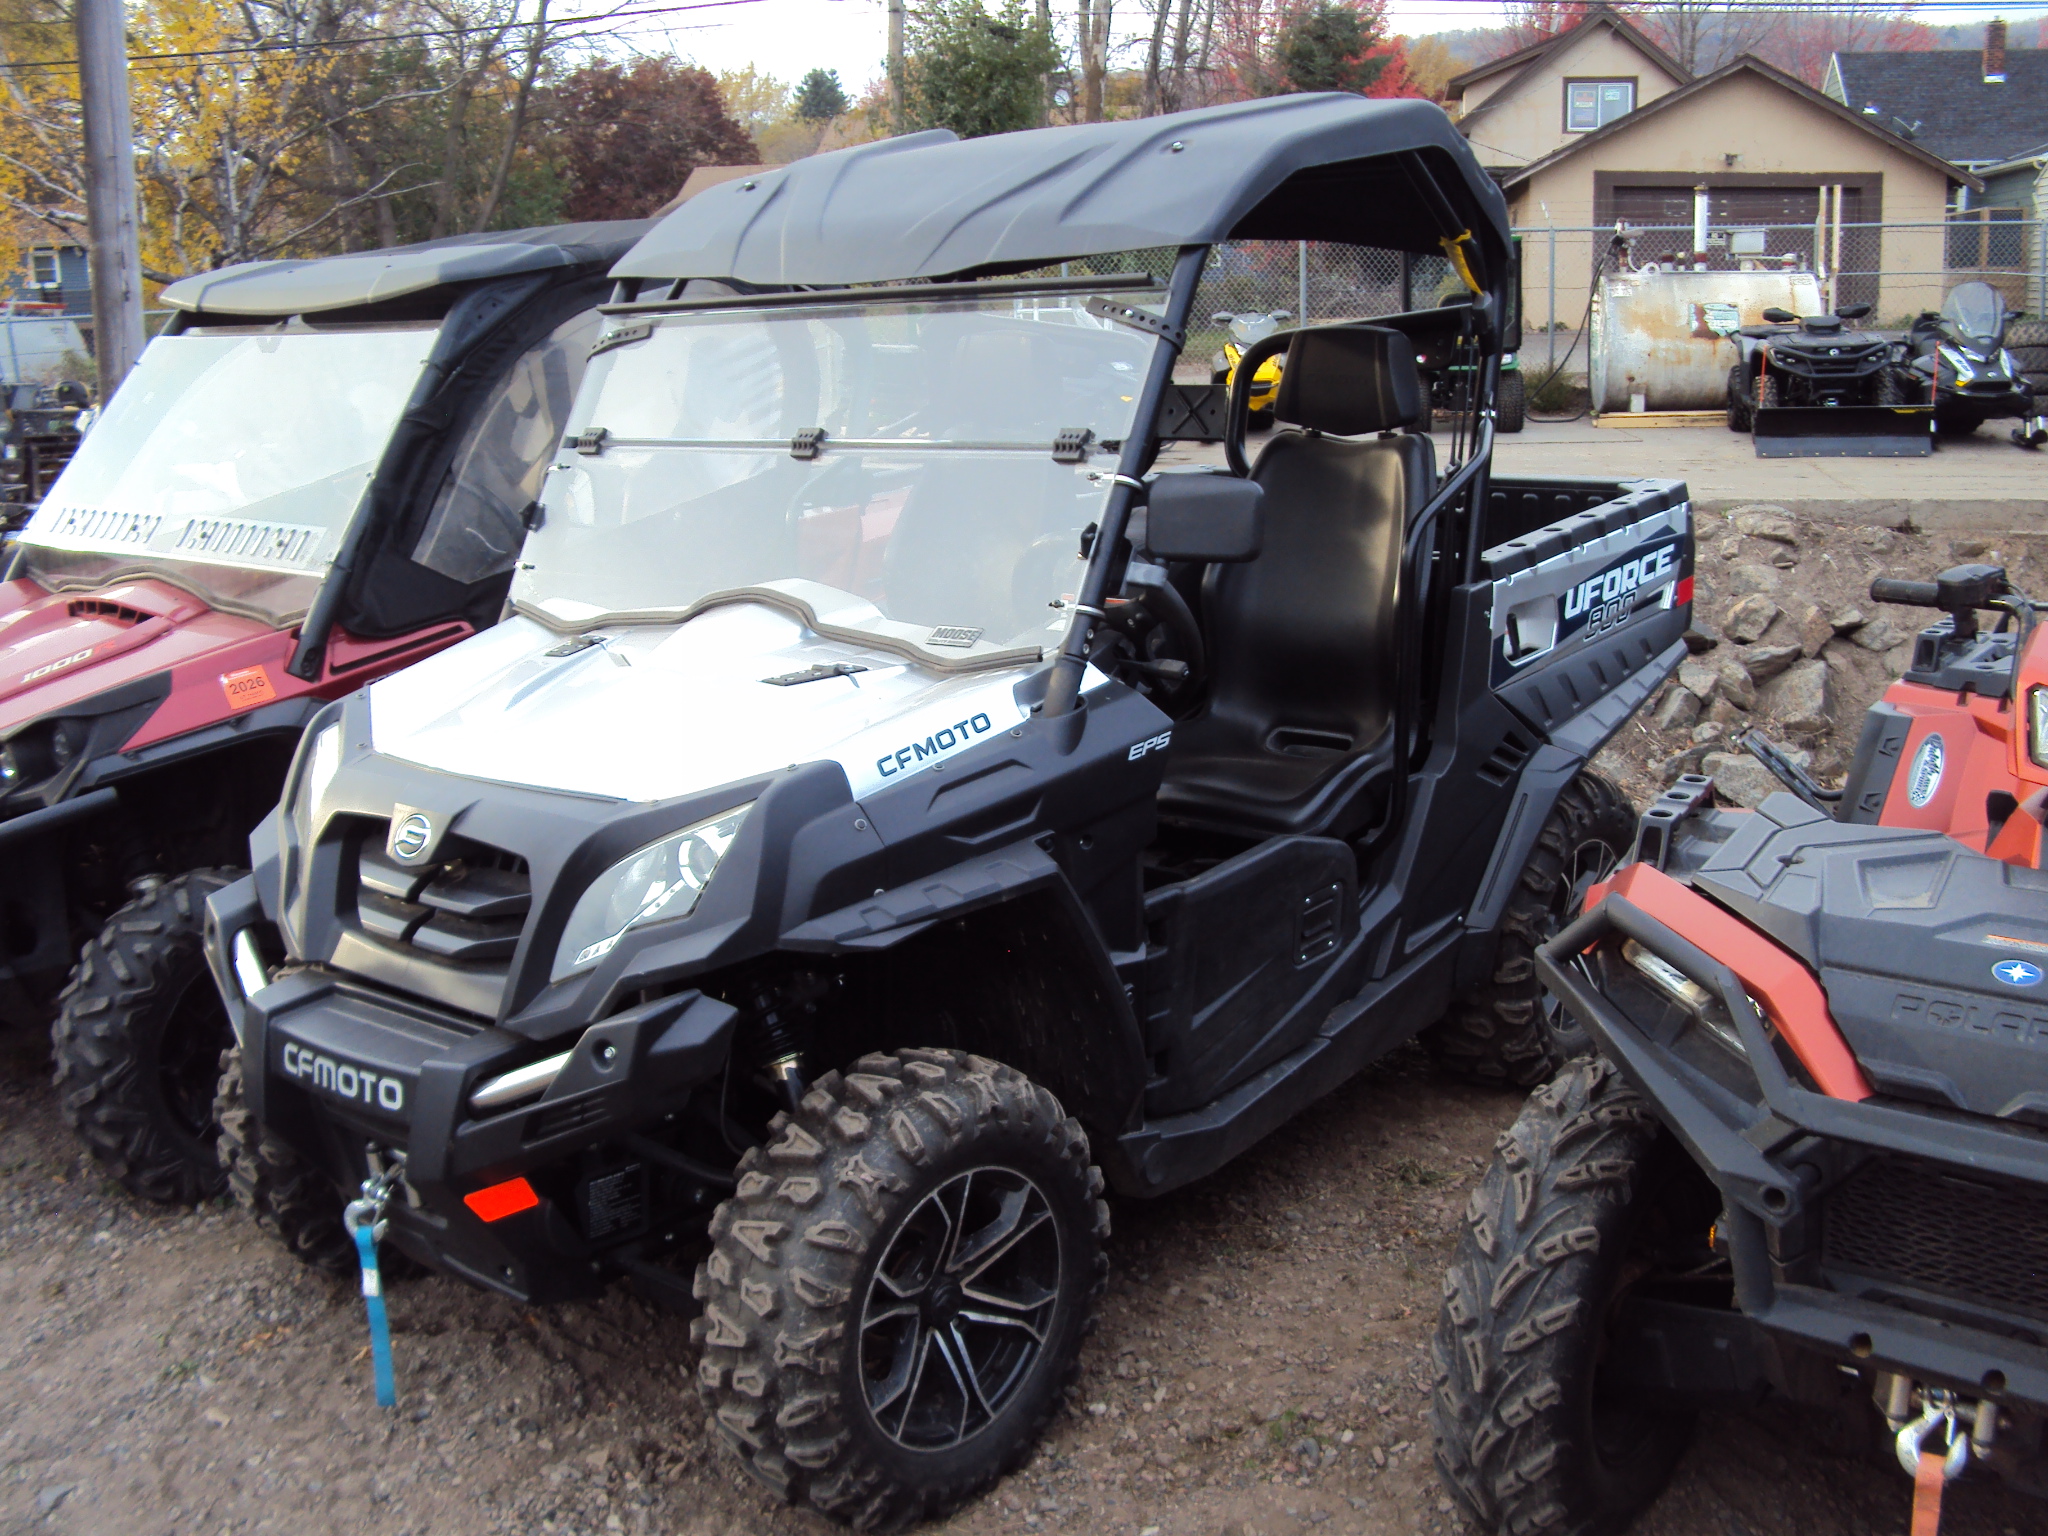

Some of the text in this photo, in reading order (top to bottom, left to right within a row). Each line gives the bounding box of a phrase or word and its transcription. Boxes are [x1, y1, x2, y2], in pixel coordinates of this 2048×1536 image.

[1564, 543, 1675, 620] UFORCE
[931, 627, 980, 641] MOOSE
[229, 676, 266, 695] 2026
[876, 712, 992, 778] CFMOTO
[1127, 730, 1172, 761] EPS
[283, 1041, 403, 1111] CFMOTO
